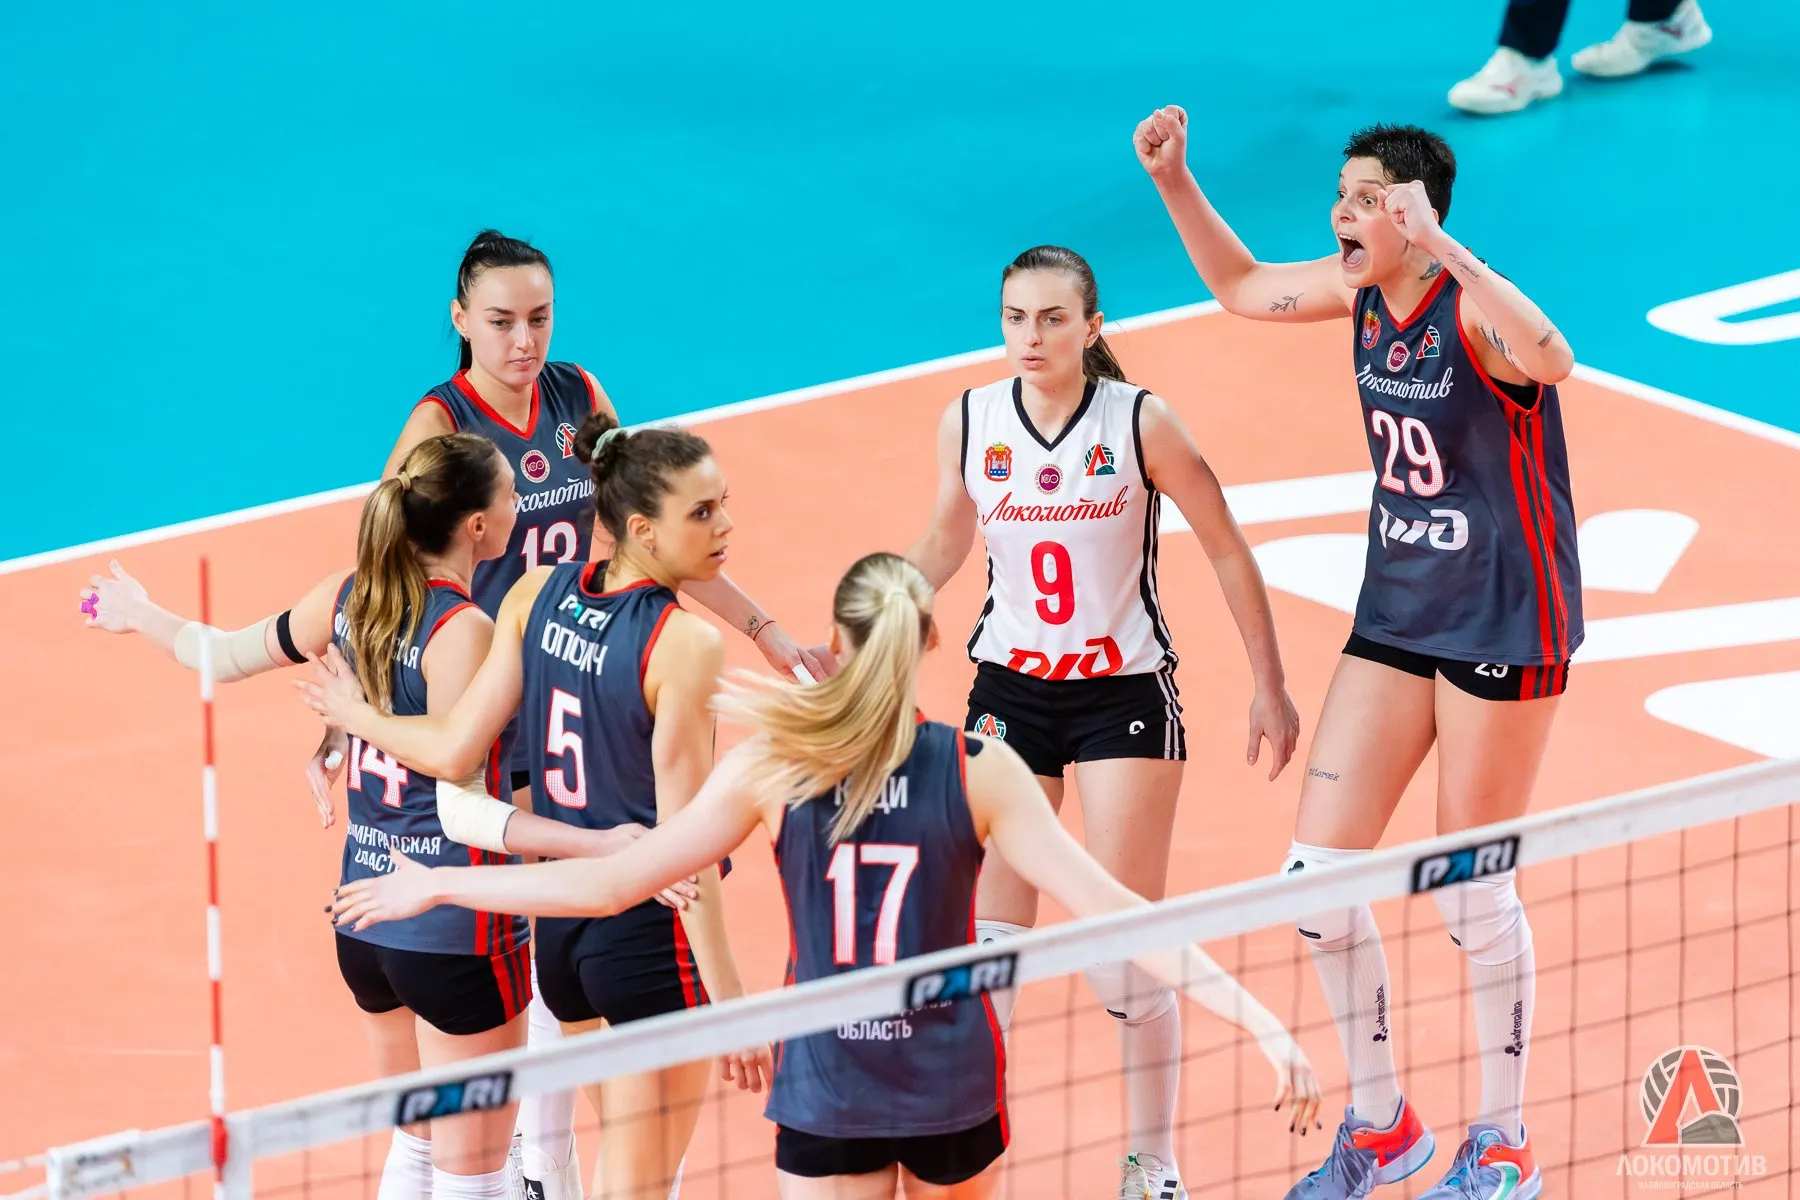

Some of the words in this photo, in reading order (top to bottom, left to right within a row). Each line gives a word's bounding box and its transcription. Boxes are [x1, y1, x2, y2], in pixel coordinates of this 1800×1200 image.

[1371, 408, 1445, 498] 29
[982, 485, 1129, 527] Локомотив
[1030, 540, 1076, 626] 9
[543, 686, 588, 810] 5
[1418, 838, 1515, 892] PARI
[825, 843, 920, 966] 17
[911, 958, 1013, 1009] PARI
[836, 1019, 913, 1041] ОБЛАСТЬ
[402, 1075, 508, 1123] PARI
